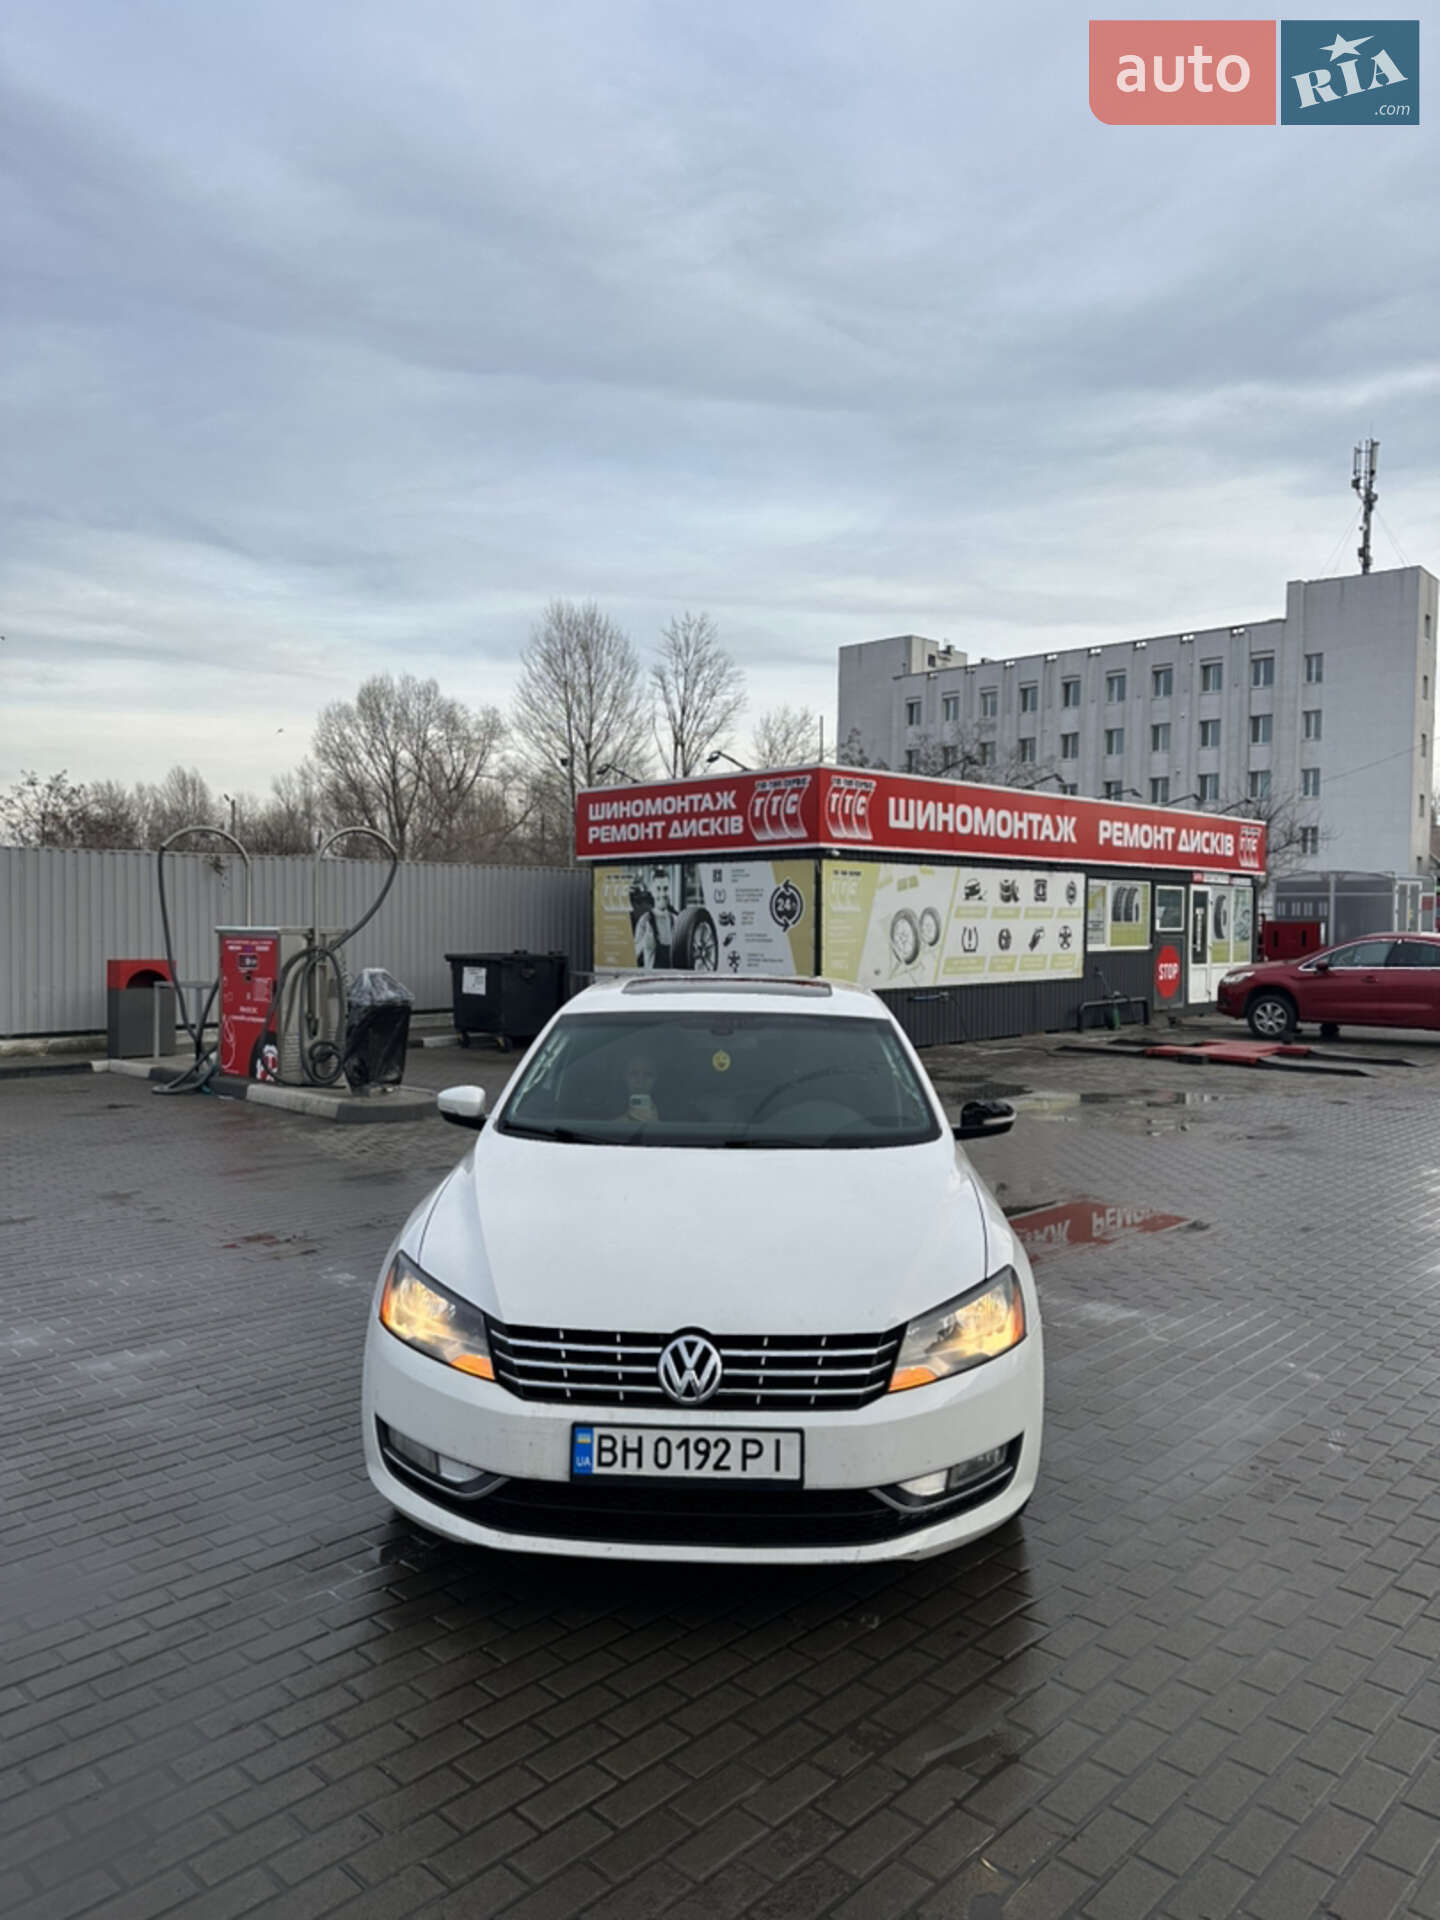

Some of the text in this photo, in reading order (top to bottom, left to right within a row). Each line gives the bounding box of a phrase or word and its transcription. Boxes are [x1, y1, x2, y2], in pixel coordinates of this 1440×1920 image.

[588, 790, 736, 821] ШИНОМОНТАЖ
[888, 796, 1078, 844] ШИНОМОНТАЖ
[587, 815, 744, 844] РЕМОНТ ДИСКІВ
[1098, 819, 1235, 858] РЕМОНТ ДИСКІВ
[1158, 962, 1179, 982] STOP
[576, 1456, 591, 1467] UA
[597, 1435, 782, 1473] BH 0192 PI
